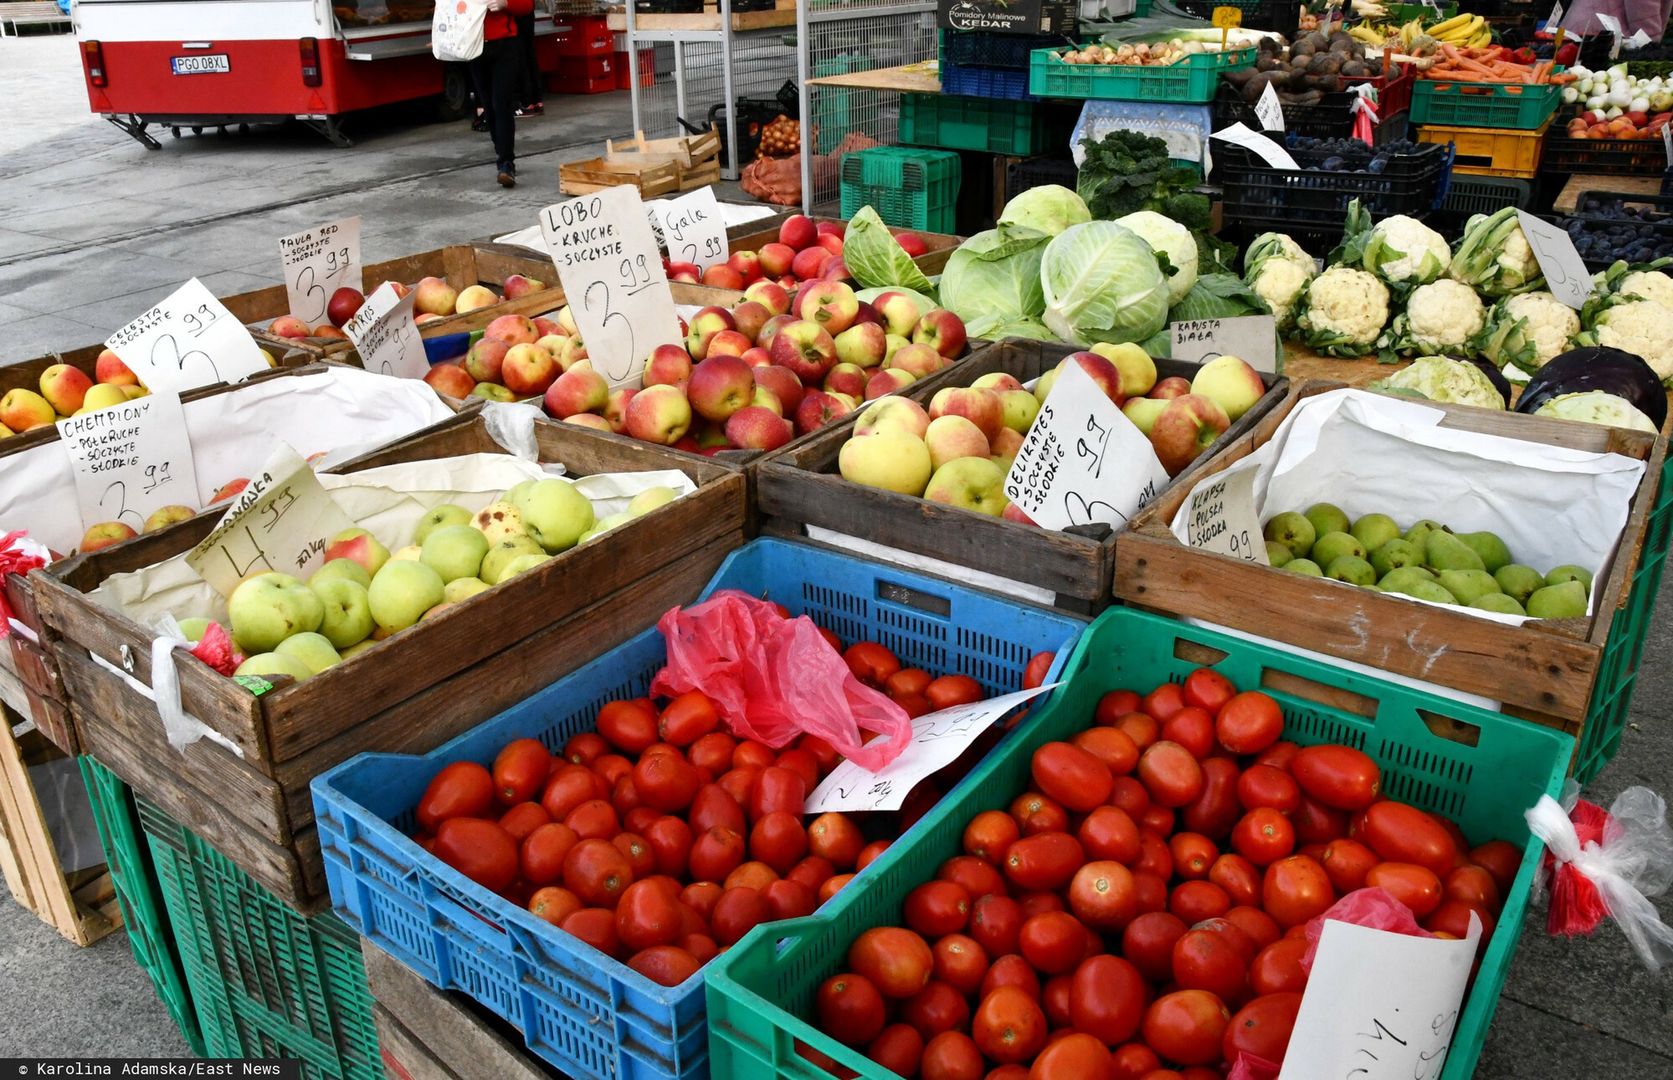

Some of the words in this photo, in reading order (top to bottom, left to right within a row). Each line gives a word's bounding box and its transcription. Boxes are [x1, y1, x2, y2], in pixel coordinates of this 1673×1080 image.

[949, 10, 985, 20] Pomidory
[988, 12, 1026, 21] Malinowe
[961, 19, 1012, 29] KEDAR
[177, 58, 199, 71] PGO
[202, 57, 227, 69] 08XL
[548, 197, 602, 232] LOBO
[666, 209, 708, 241] Gala
[280, 233, 312, 248] PAULA
[320, 225, 338, 236] RED
[705, 237, 722, 258] 99
[326, 247, 349, 271] 99
[620, 254, 651, 288] 99
[109, 307, 161, 344] CELESTA
[183, 303, 216, 333] 99
[1178, 320, 1220, 331] KAPUSTA
[1177, 331, 1214, 344] BIAŁA
[64, 403, 150, 438] CHEMPIONY
[1007, 405, 1053, 499] DELIKATES
[1077, 414, 1105, 472] 99
[144, 462, 172, 489] 99
[261, 486, 295, 529] 99
[1191, 482, 1226, 510] KLAPSA
[1230, 530, 1252, 559] 99
